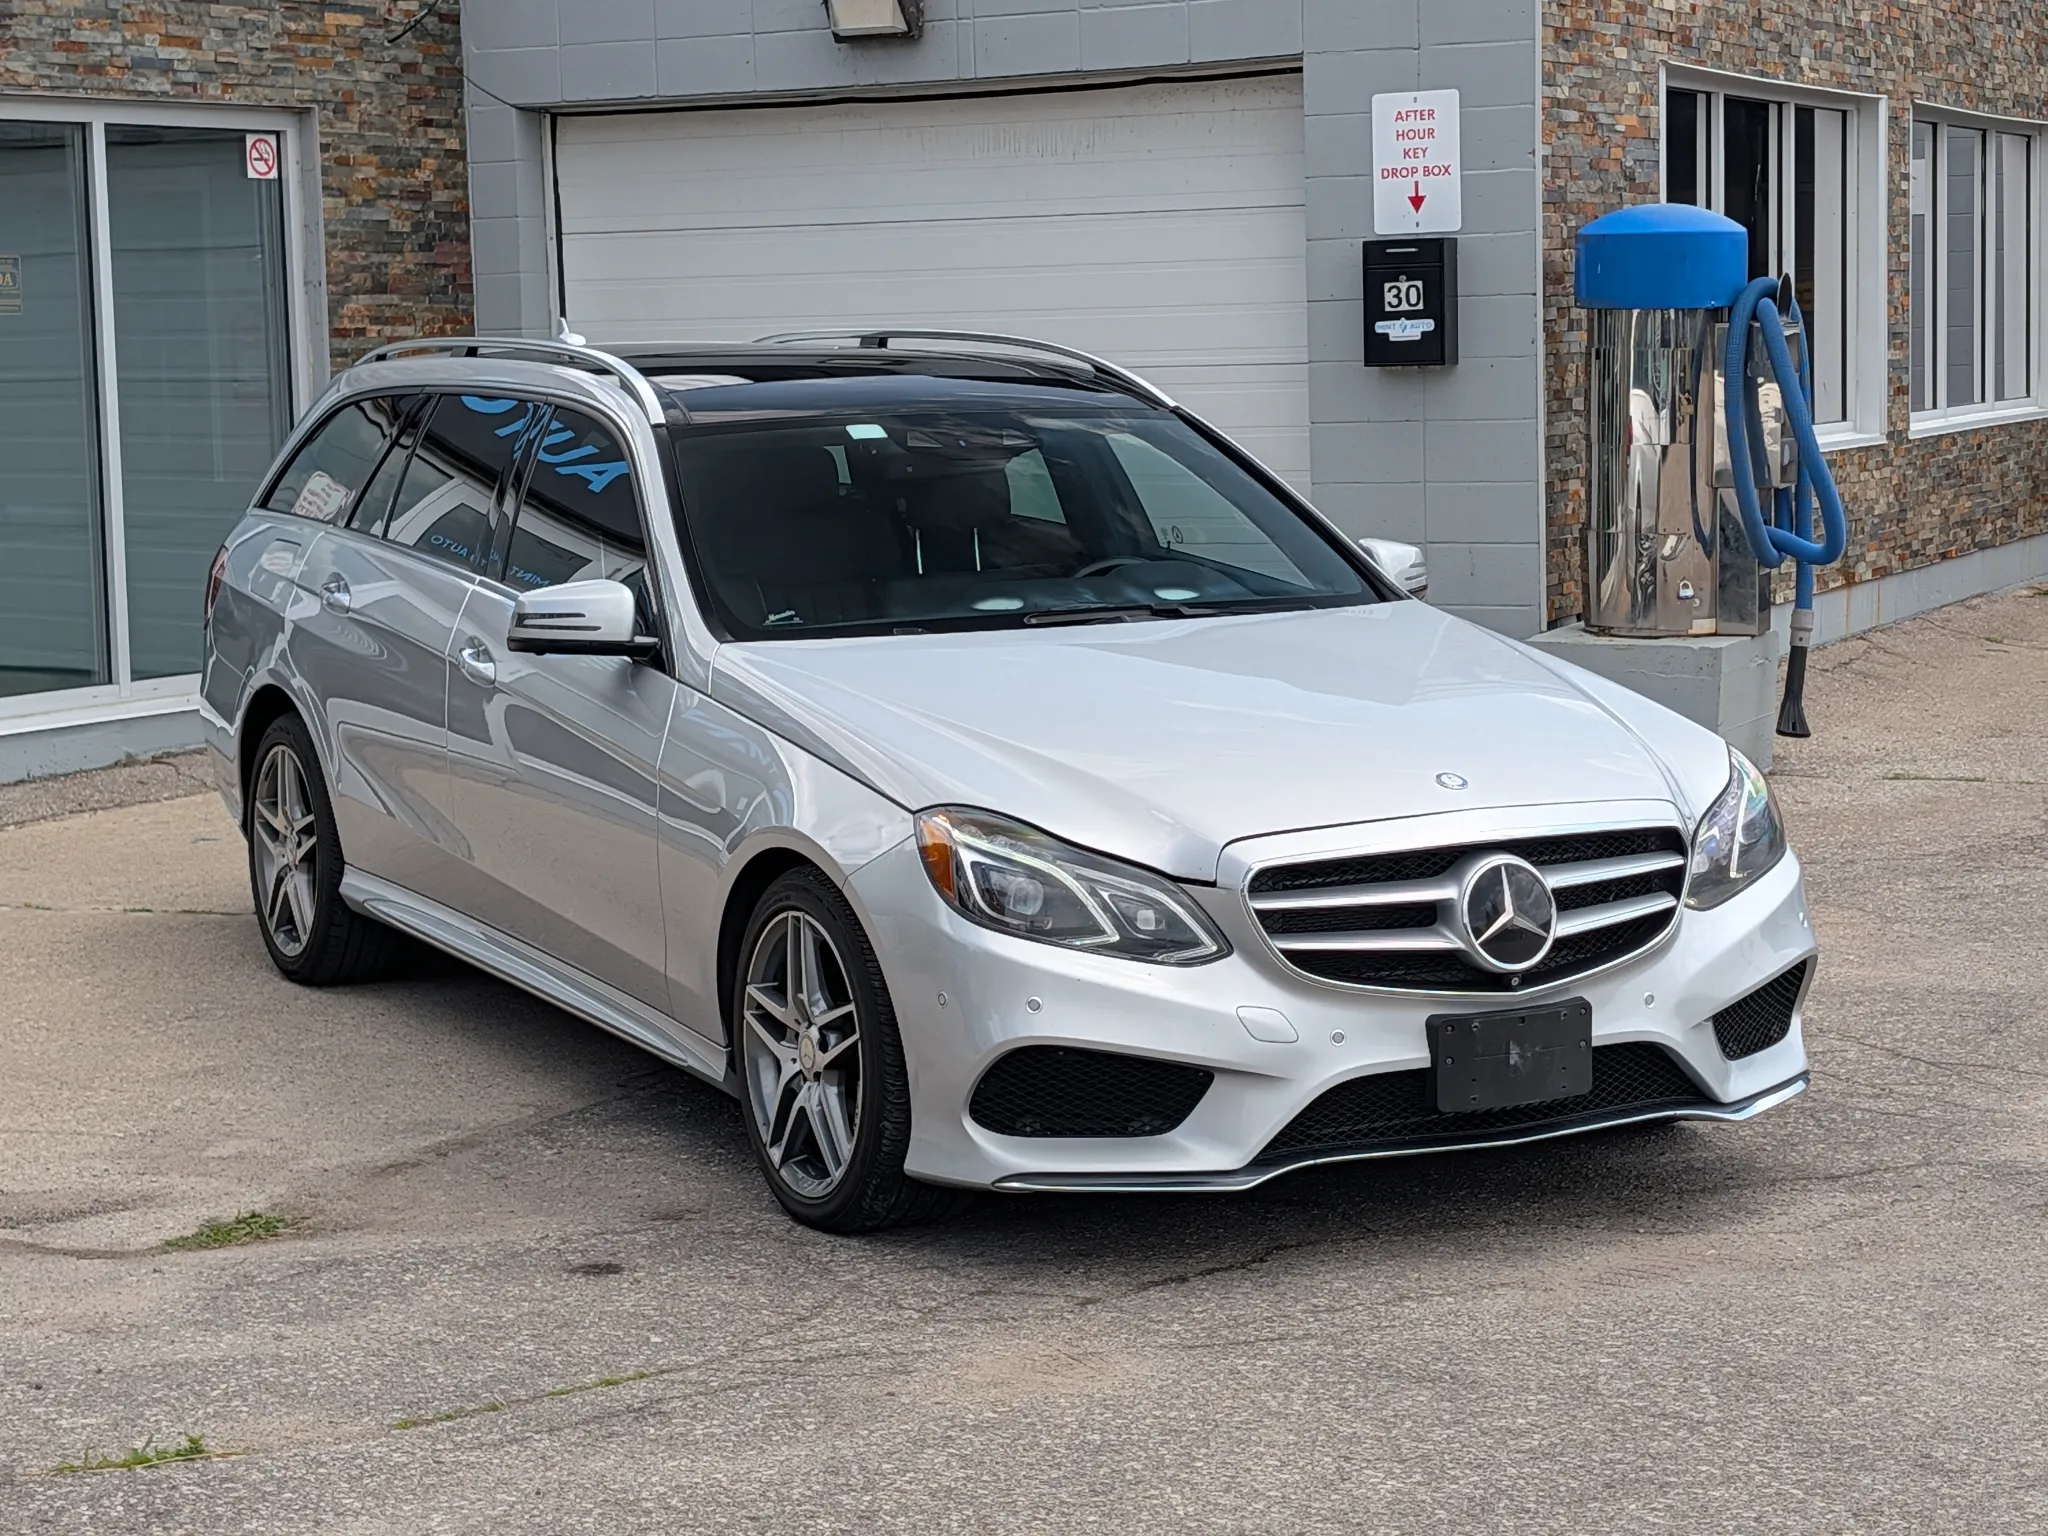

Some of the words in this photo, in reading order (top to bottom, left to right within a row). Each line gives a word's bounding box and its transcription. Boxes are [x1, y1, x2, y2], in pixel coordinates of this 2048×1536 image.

[1394, 109, 1436, 122] AFTER
[1395, 127, 1436, 141] HOUR
[1403, 147, 1428, 160] KEY
[1381, 166, 1419, 180] DROP
[1422, 164, 1452, 177] BOX
[1386, 284, 1422, 309] 30
